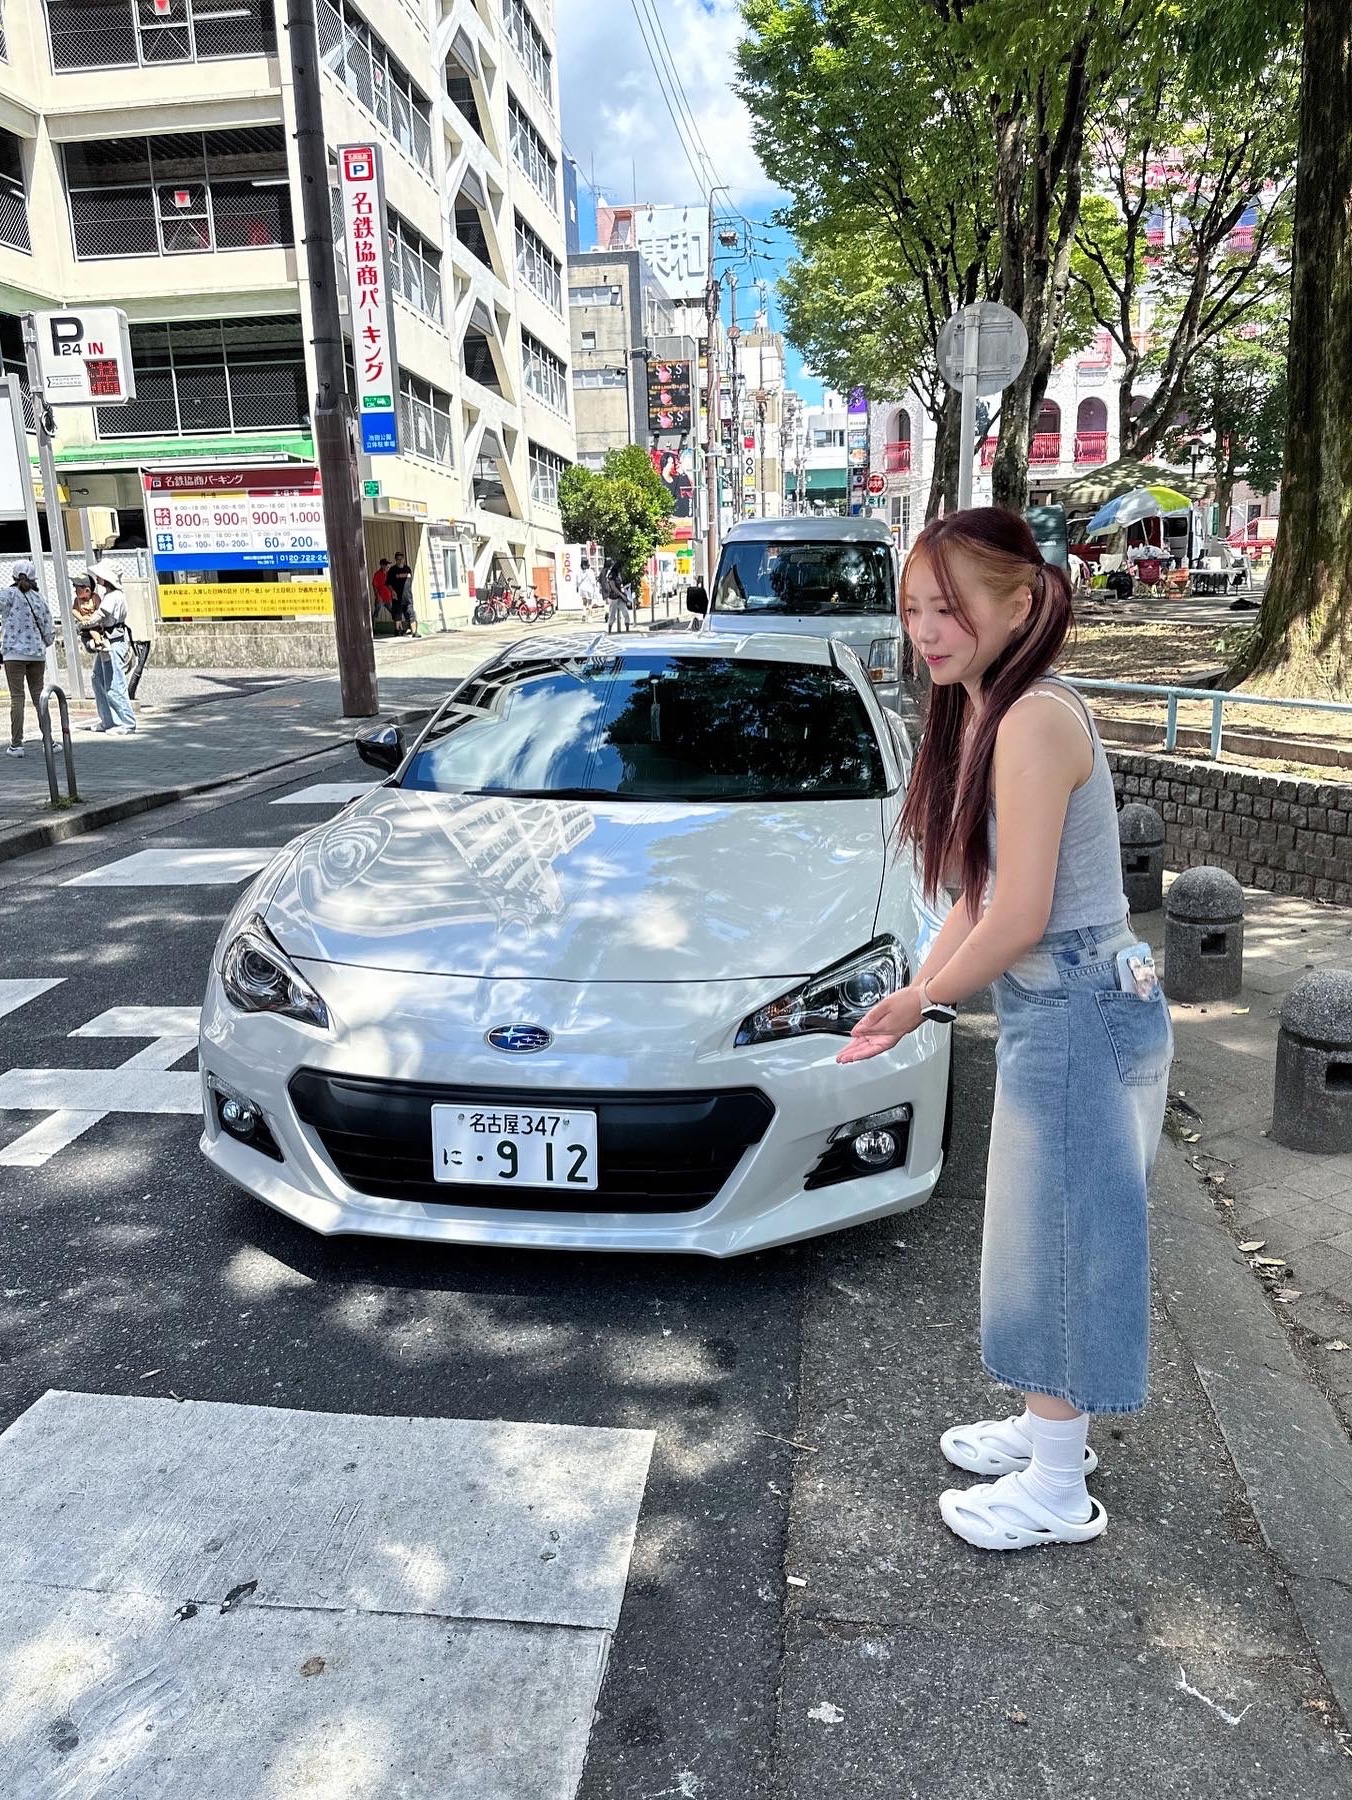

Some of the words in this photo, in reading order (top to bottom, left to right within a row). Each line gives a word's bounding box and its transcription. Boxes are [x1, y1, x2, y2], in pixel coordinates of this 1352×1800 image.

[353, 165, 365, 175] P
[352, 192, 384, 382] 名鉄協商パーキング
[50, 317, 84, 356] P
[62, 343, 82, 355] 24
[88, 342, 104, 355] IN
[165, 474, 244, 487] 名鉄協商パーキング
[564, 553, 572, 582] DyDo
[443, 1148, 463, 1166] に
